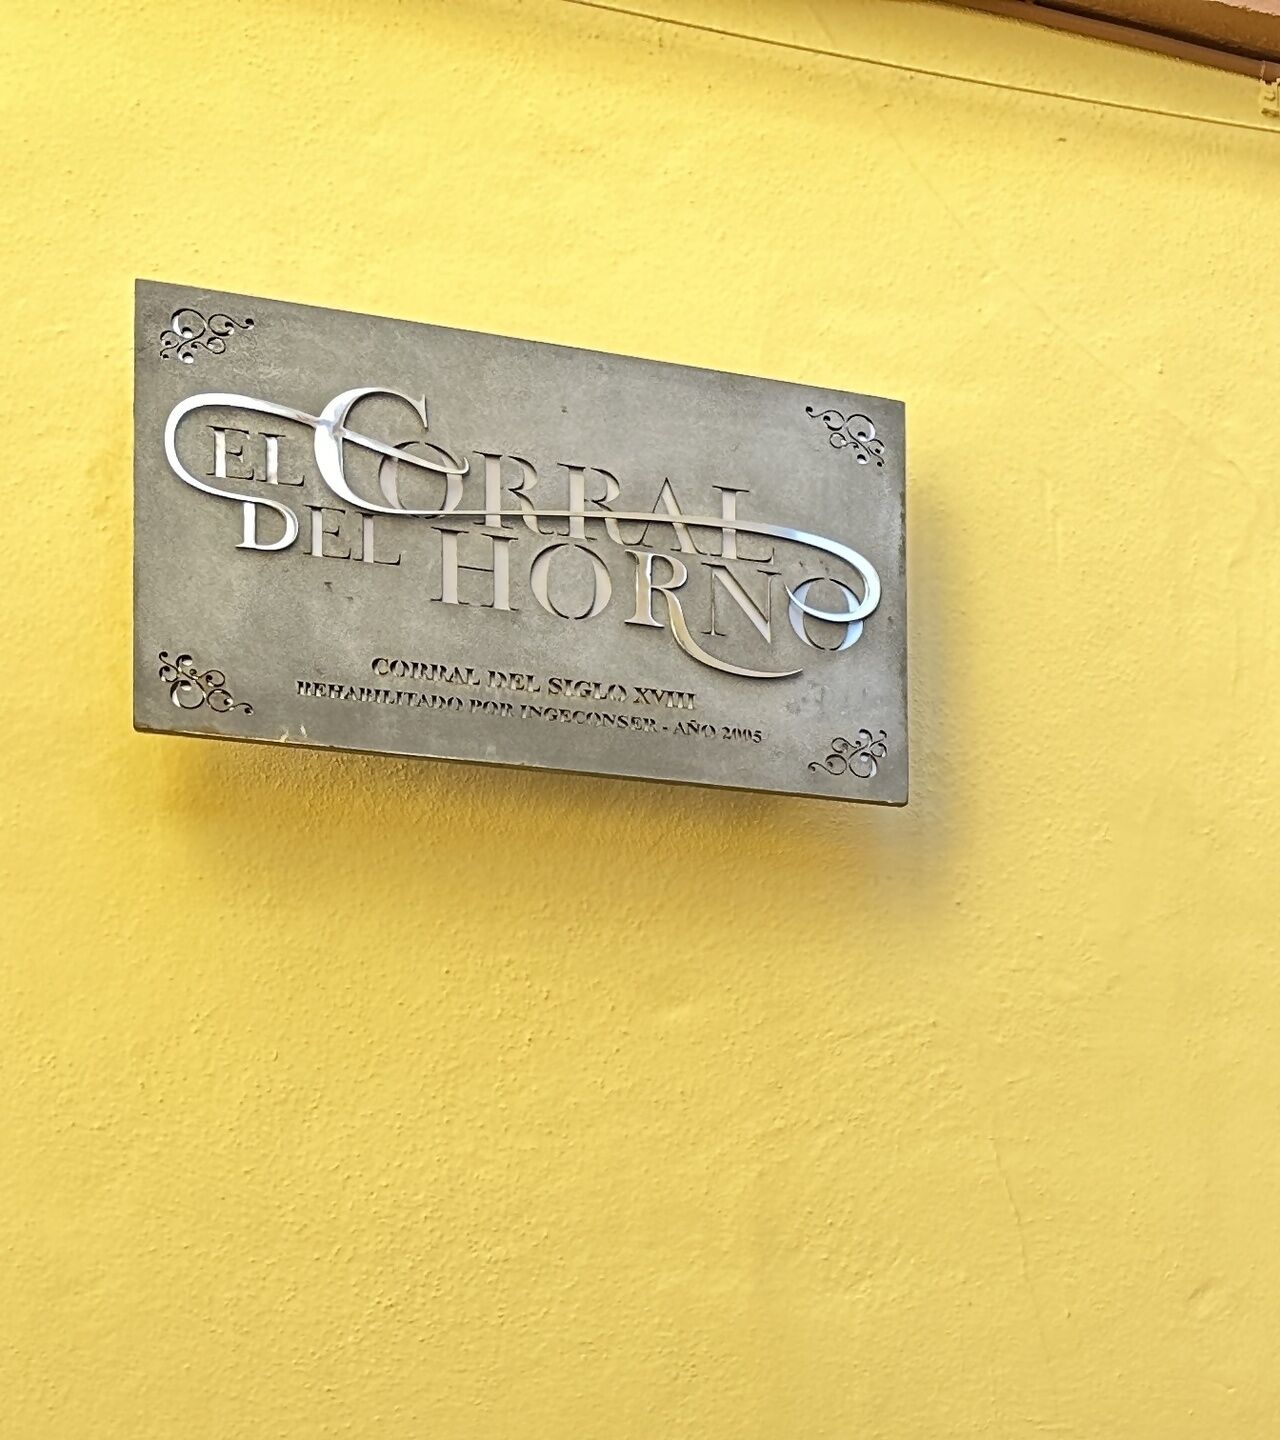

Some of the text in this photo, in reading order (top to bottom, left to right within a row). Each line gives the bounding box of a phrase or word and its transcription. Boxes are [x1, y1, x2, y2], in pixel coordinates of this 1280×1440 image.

[206, 386, 776, 566] EL CORRAL
[235, 496, 866, 678] DEL HORNO
[296, 680, 464, 712] REHABILITADO
[468, 699, 514, 718] POR
[520, 703, 658, 734] INGECONSER
[673, 719, 717, 739] AÑO
[722, 726, 763, 744] 2005
[371, 657, 697, 711] CORRAL DEL SIGLO XVIII
